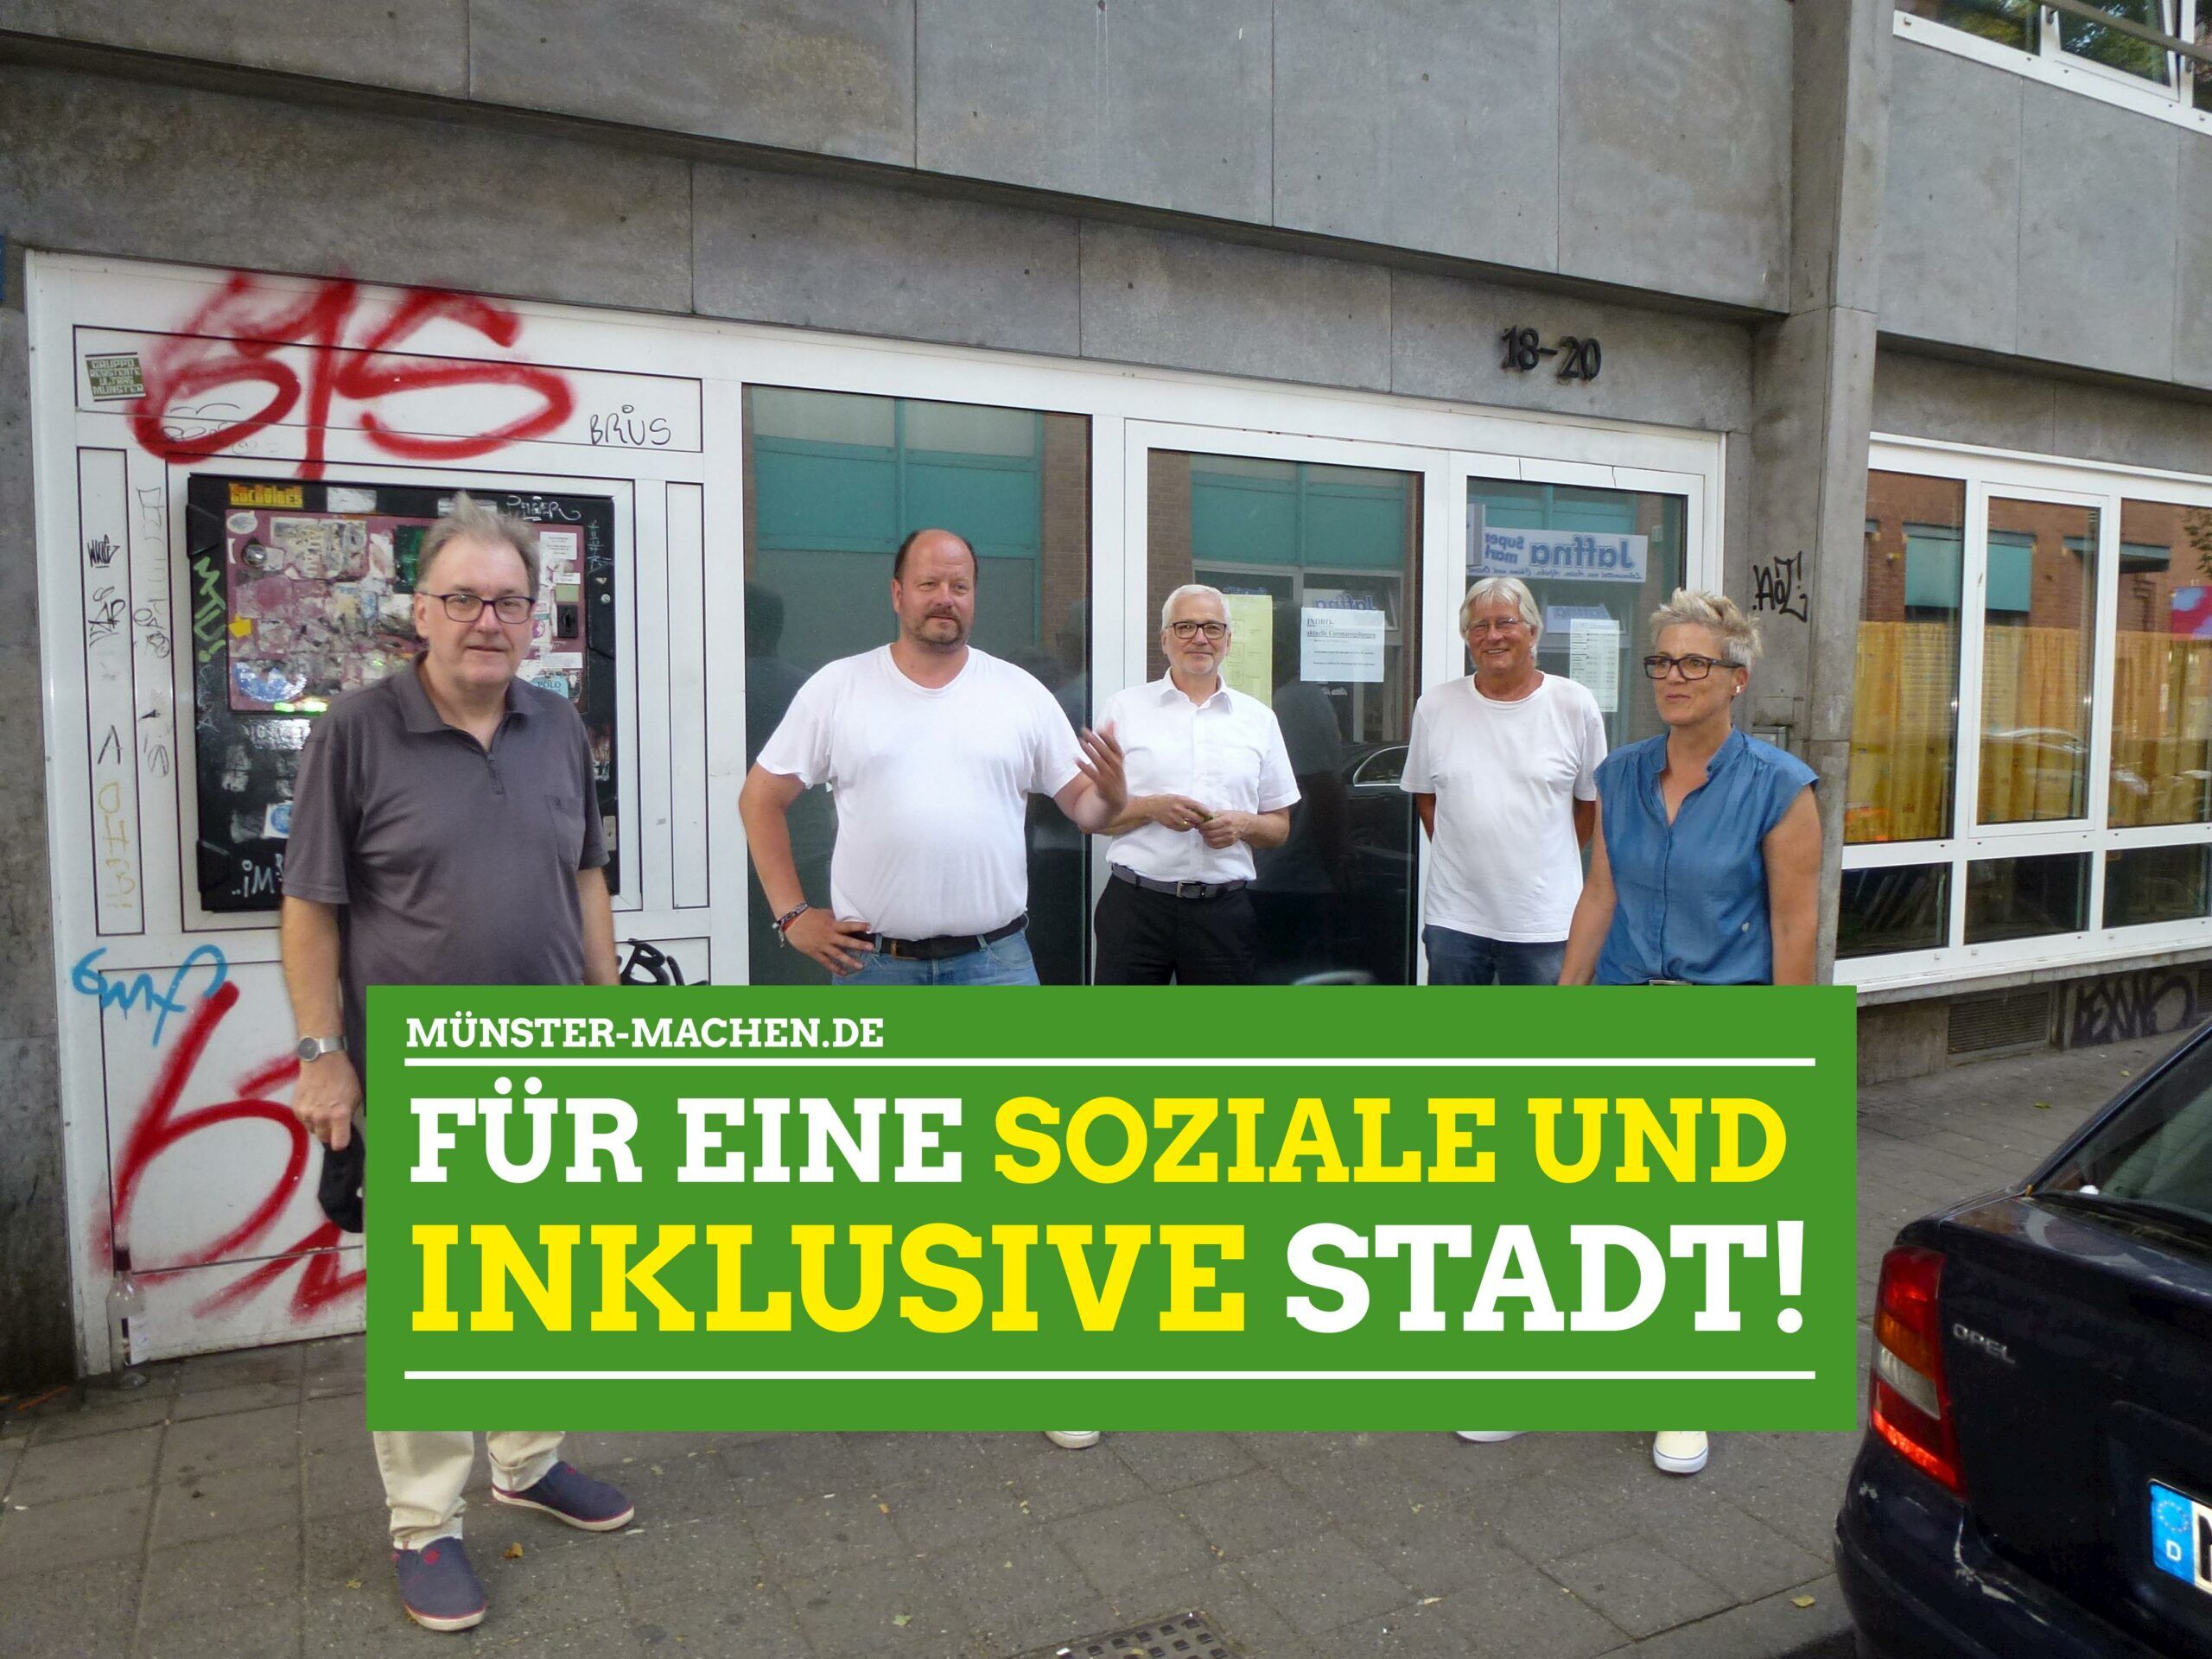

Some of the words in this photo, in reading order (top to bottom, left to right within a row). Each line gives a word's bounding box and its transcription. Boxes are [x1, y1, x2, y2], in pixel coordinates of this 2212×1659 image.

[1502, 325, 1601, 380] 18-20
[1953, 1323, 2016, 1363] OPEL
[2165, 1539, 2182, 1562] D
